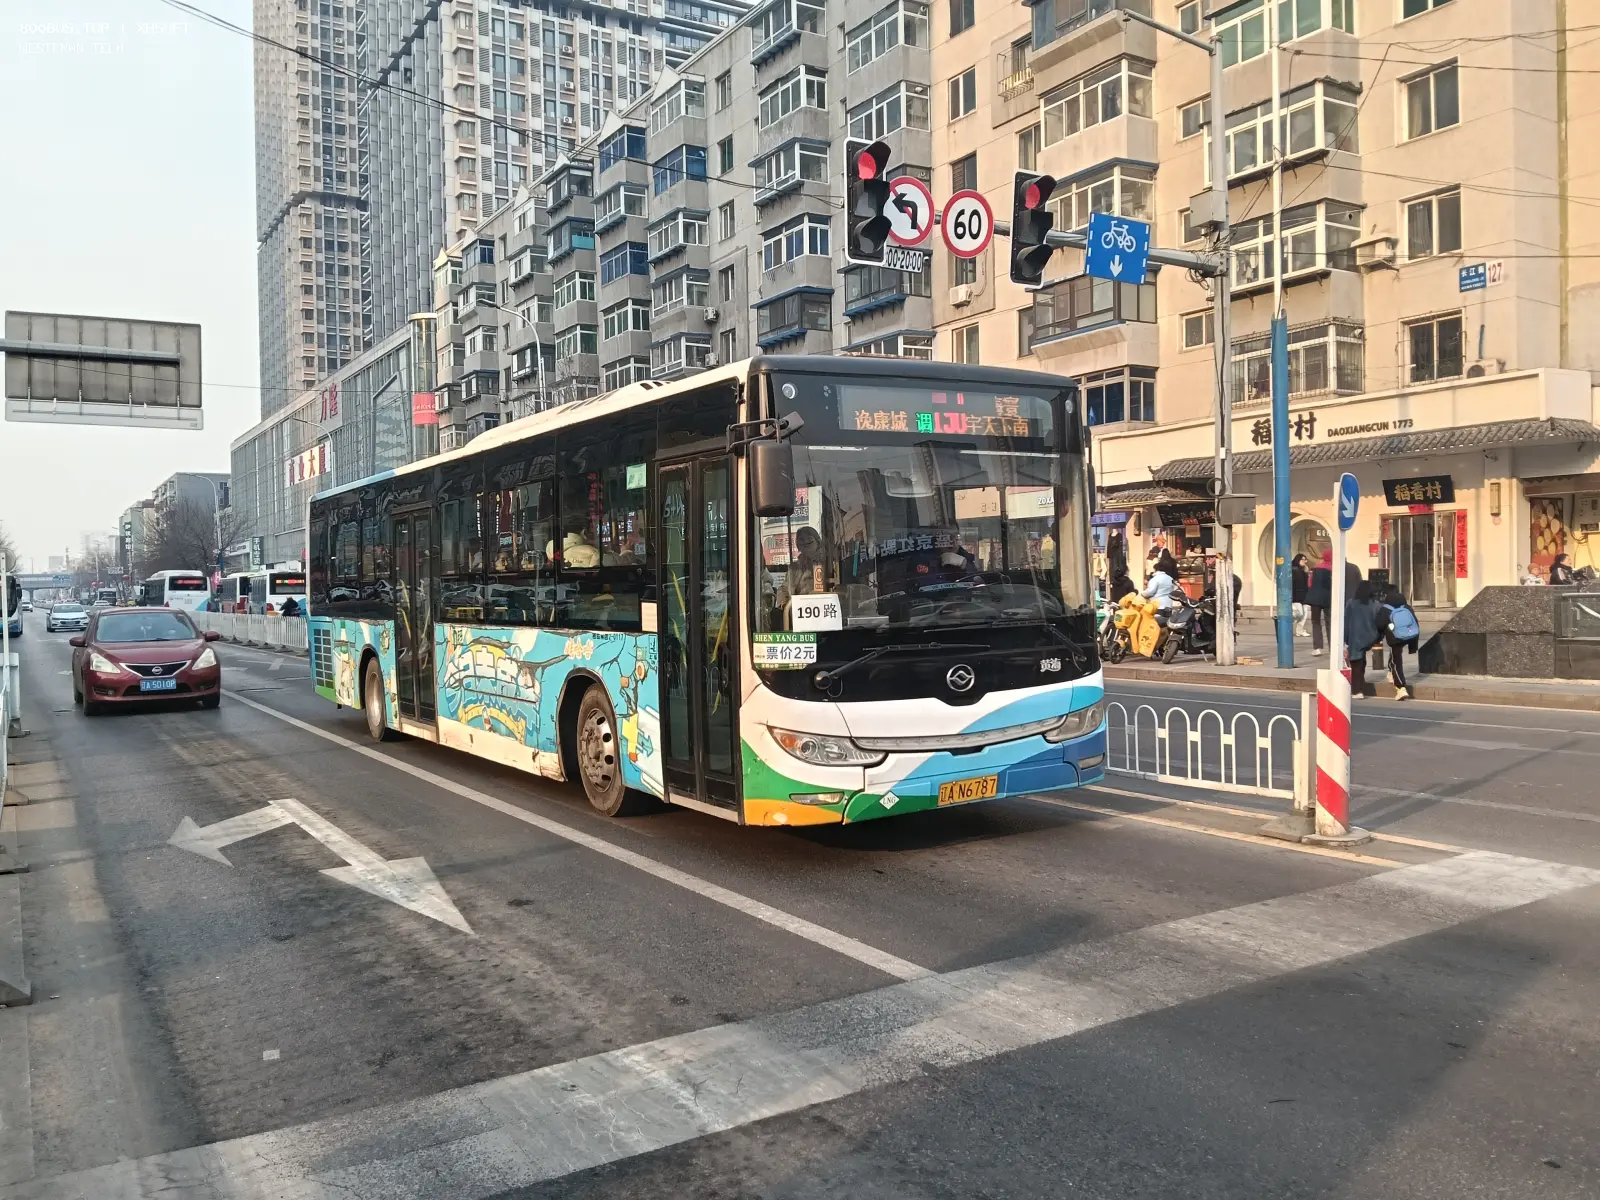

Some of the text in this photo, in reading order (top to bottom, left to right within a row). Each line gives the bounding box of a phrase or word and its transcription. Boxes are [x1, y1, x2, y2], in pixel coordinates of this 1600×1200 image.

[953, 208, 982, 240] 60
[1488, 262, 1502, 283] 127
[320, 383, 339, 423] 万隆
[1251, 411, 1317, 447] 稻村
[1327, 418, 1414, 438] DAOXIANGCUN 1773
[289, 444, 327, 486] 商业大厦
[1394, 480, 1442, 501] 稻香村
[797, 603, 838, 619] 190 路
[754, 634, 814, 642] SHEN YANG BUS
[766, 646, 815, 660] 票价2元
